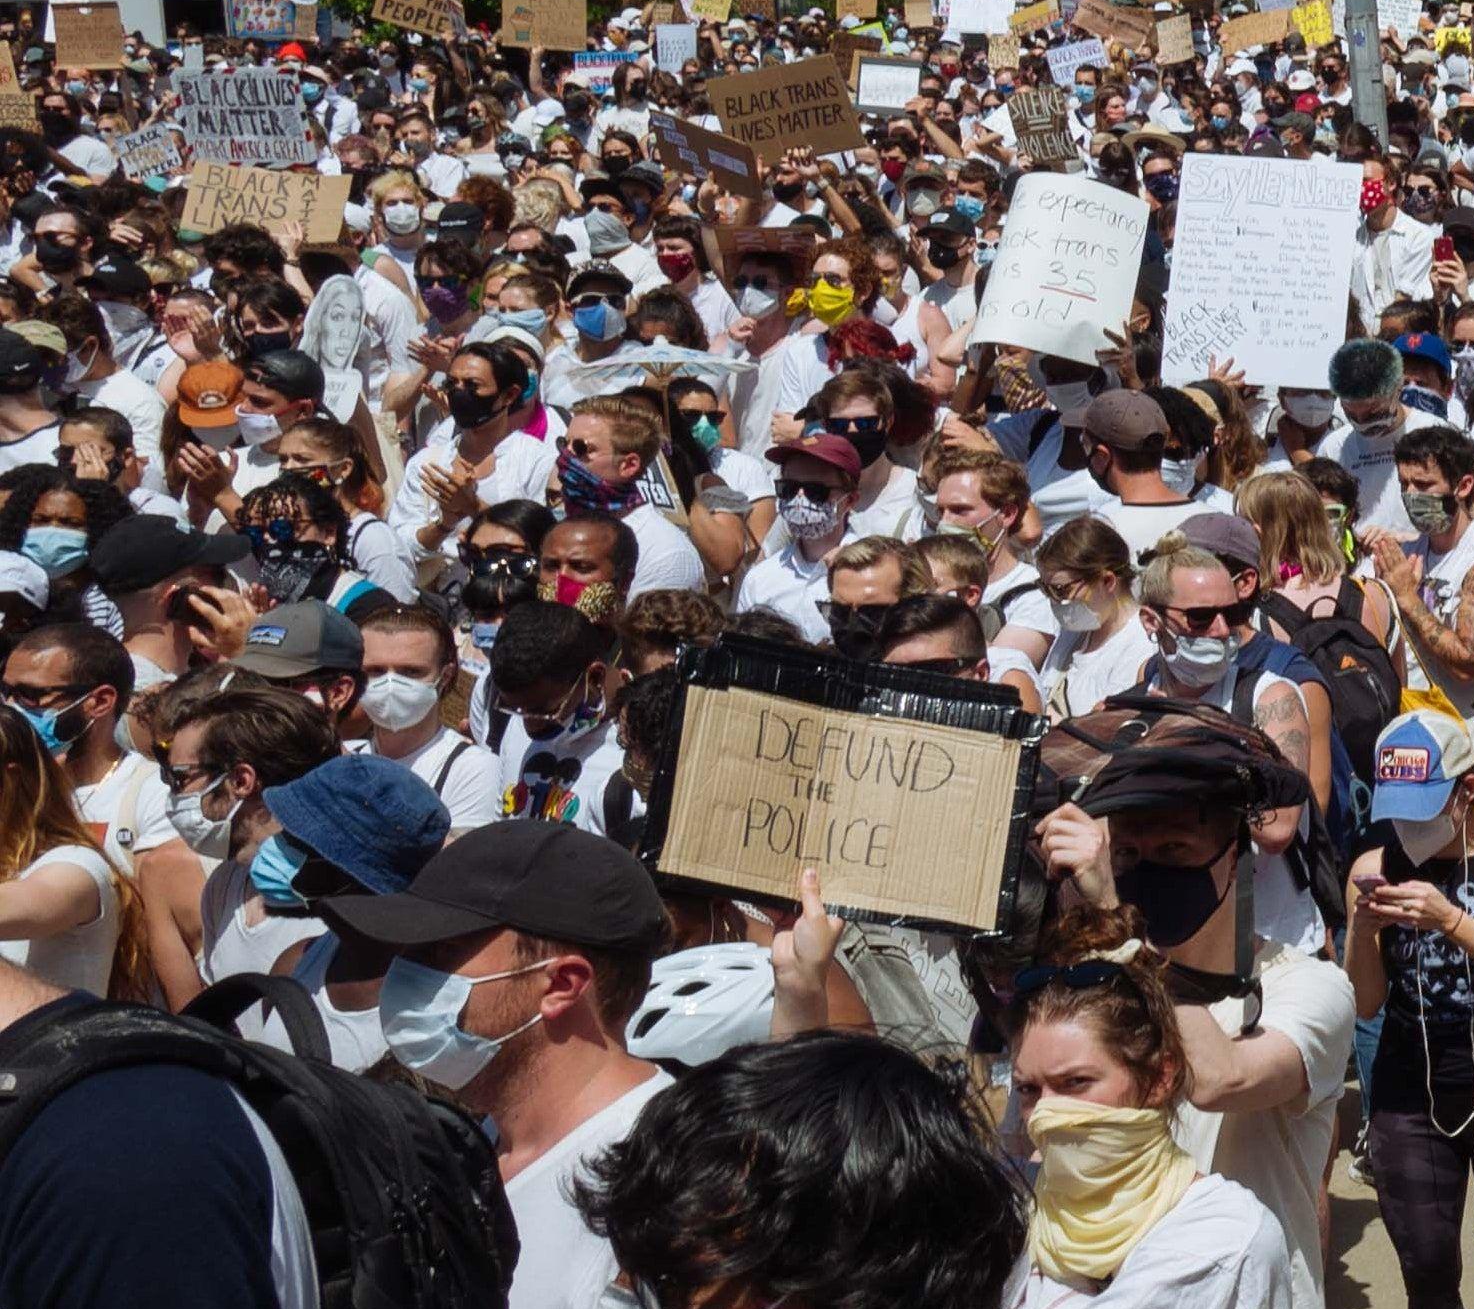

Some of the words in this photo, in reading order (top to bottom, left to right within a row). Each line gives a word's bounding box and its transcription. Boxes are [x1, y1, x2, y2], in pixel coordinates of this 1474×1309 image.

[381, 0, 450, 33] PEOPLE
[726, 92, 783, 119] BLACK
[787, 76, 840, 107] TRANS
[1007, 89, 1065, 120] SILENCE
[197, 110, 283, 139] MATTER
[730, 118, 777, 149] LIVES
[779, 104, 845, 137] MATTER
[273, 137, 306, 162] GREAT
[207, 166, 292, 195] BLACK
[1290, 164, 1359, 210] Name
[196, 185, 289, 220] TRANS
[1038, 190, 1148, 242] expectancy
[1053, 229, 1120, 263] trans
[1001, 259, 1024, 282] is
[1046, 257, 1100, 294] 35
[1013, 293, 1075, 326] old
[1166, 299, 1213, 342] BLACK
[1164, 326, 1207, 368] TRANS
[1205, 302, 1238, 337] LIVES
[757, 708, 957, 795] DEFUND
[789, 772, 838, 804] THE
[1379, 764, 1425, 778] CUBS
[744, 798, 895, 870] POLICE
